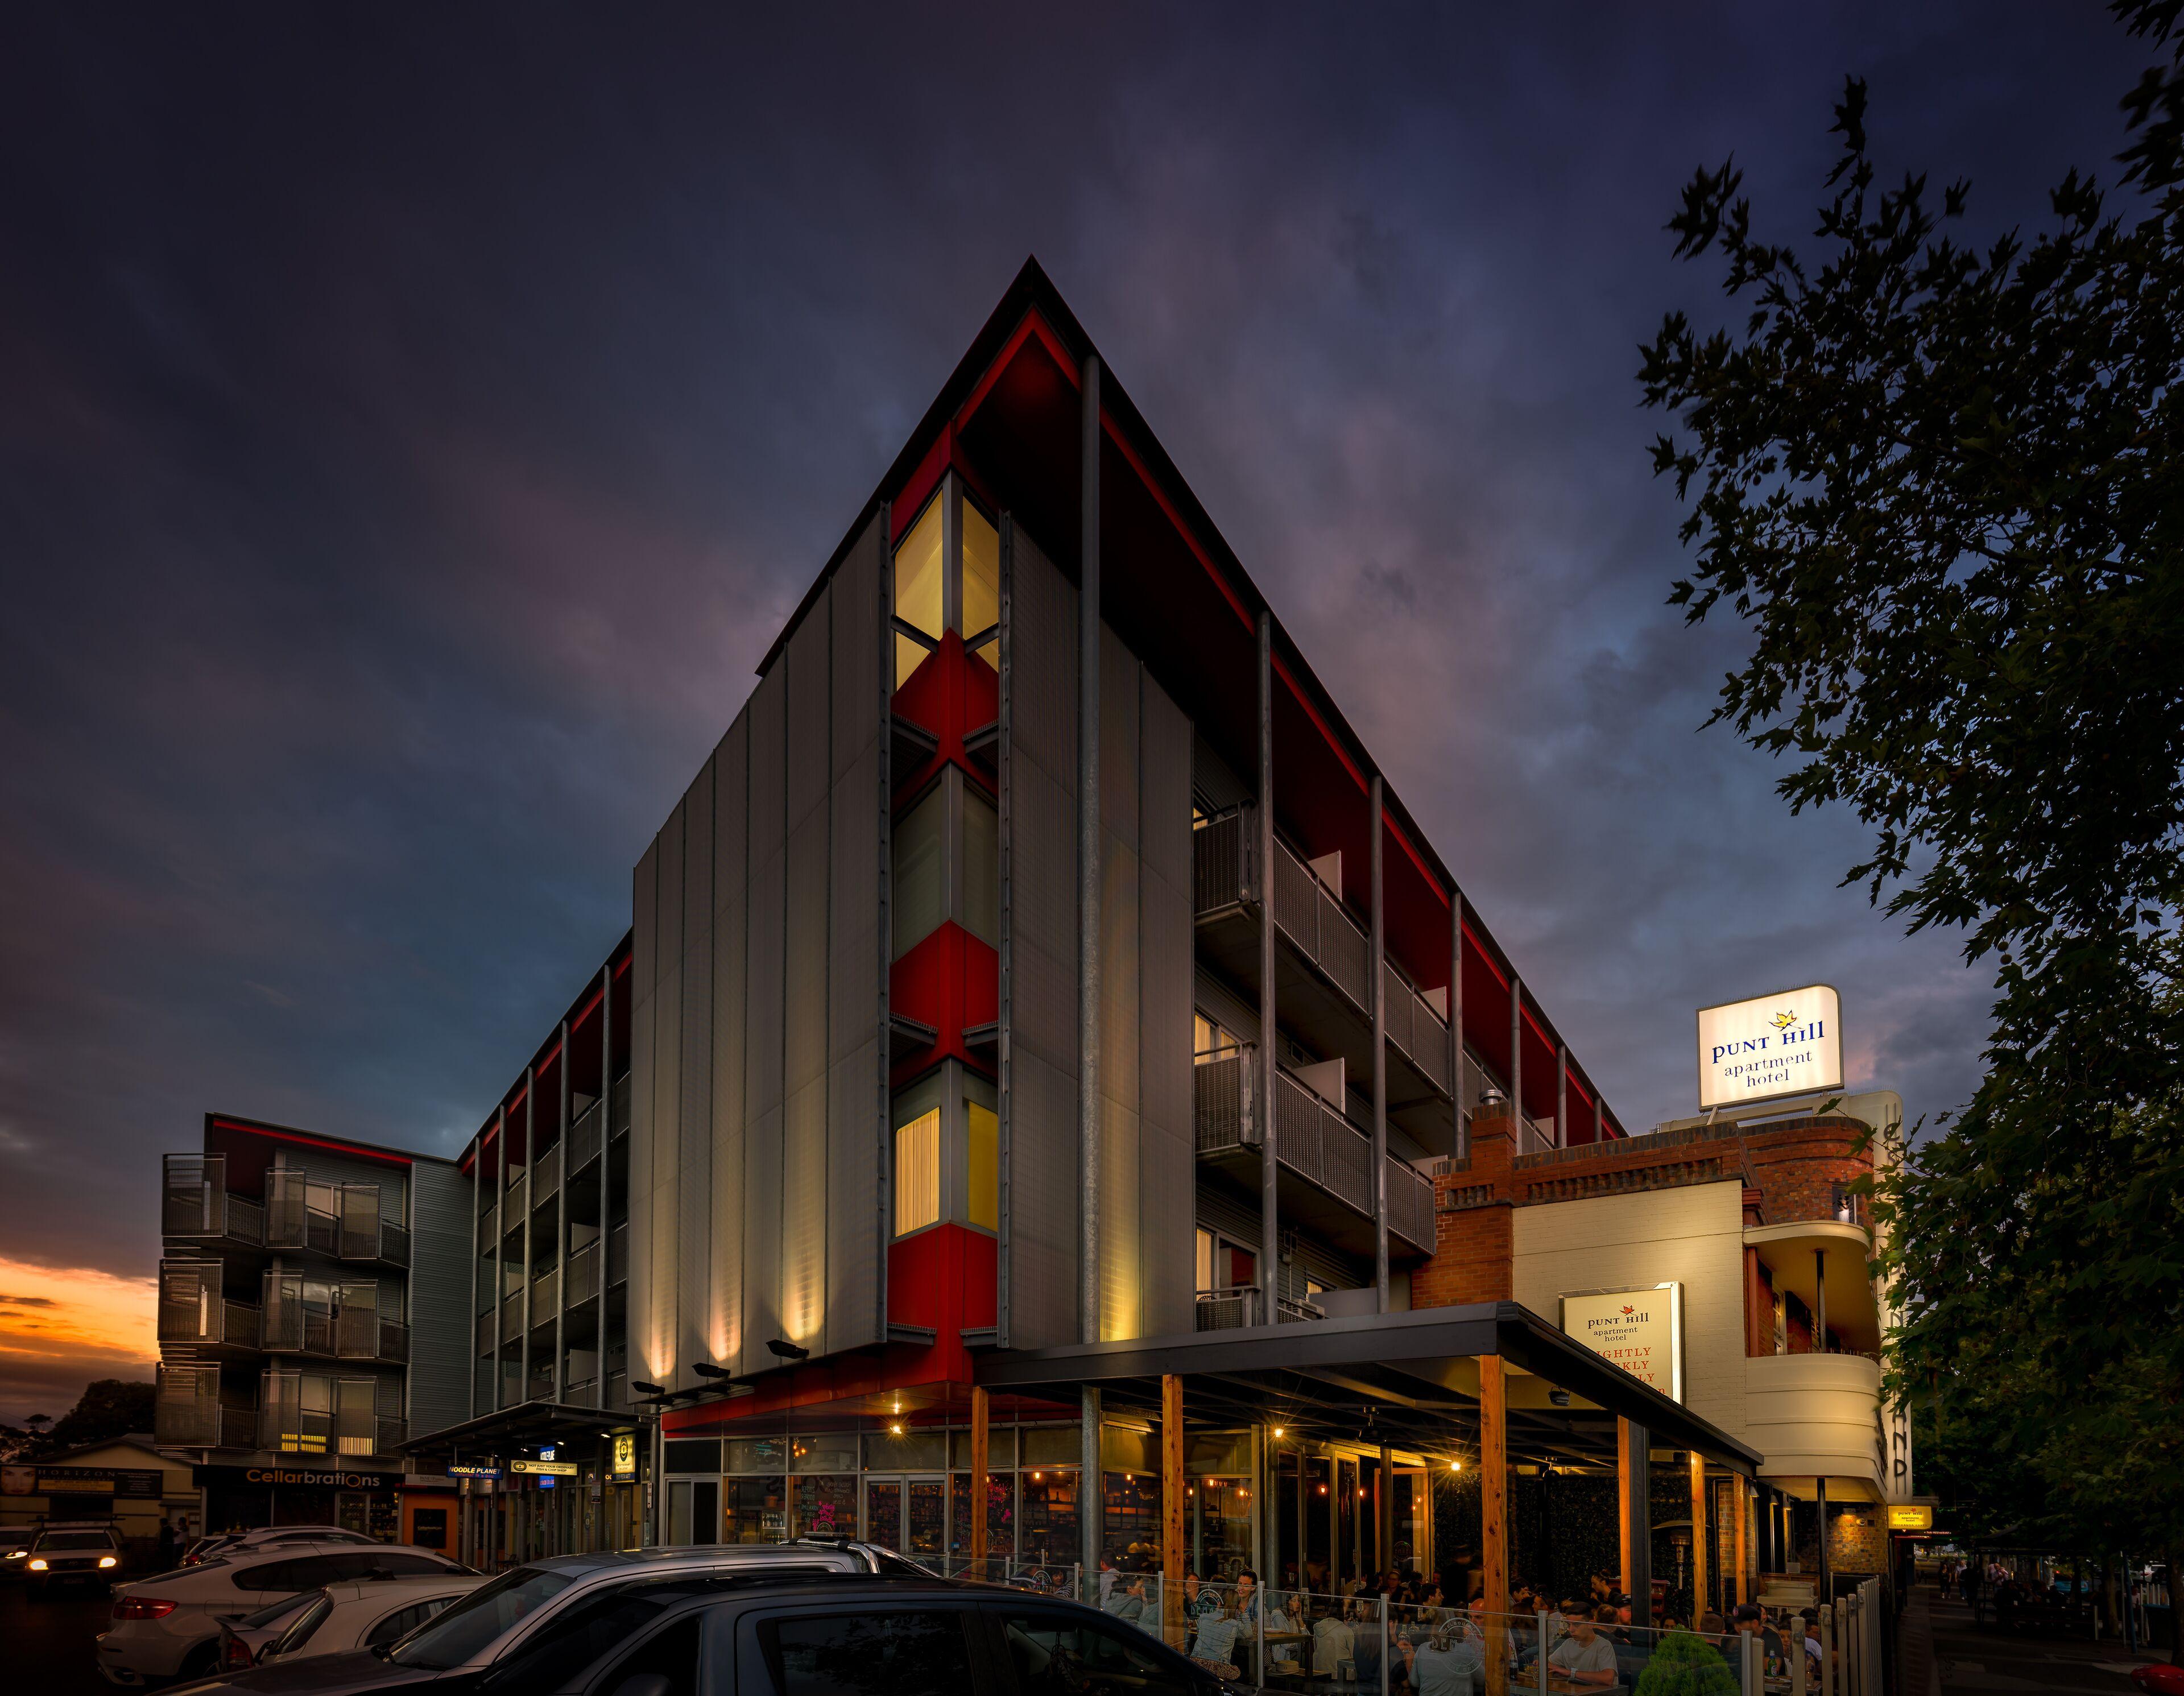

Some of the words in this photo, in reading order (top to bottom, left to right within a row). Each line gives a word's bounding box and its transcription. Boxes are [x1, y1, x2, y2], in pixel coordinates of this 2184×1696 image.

[1724, 1050, 1813, 1077] apartment
[1747, 1069, 1789, 1087] hotel
[1593, 1327, 1638, 1337] apartment
[246, 1469, 382, 1489] Cellarbrations
